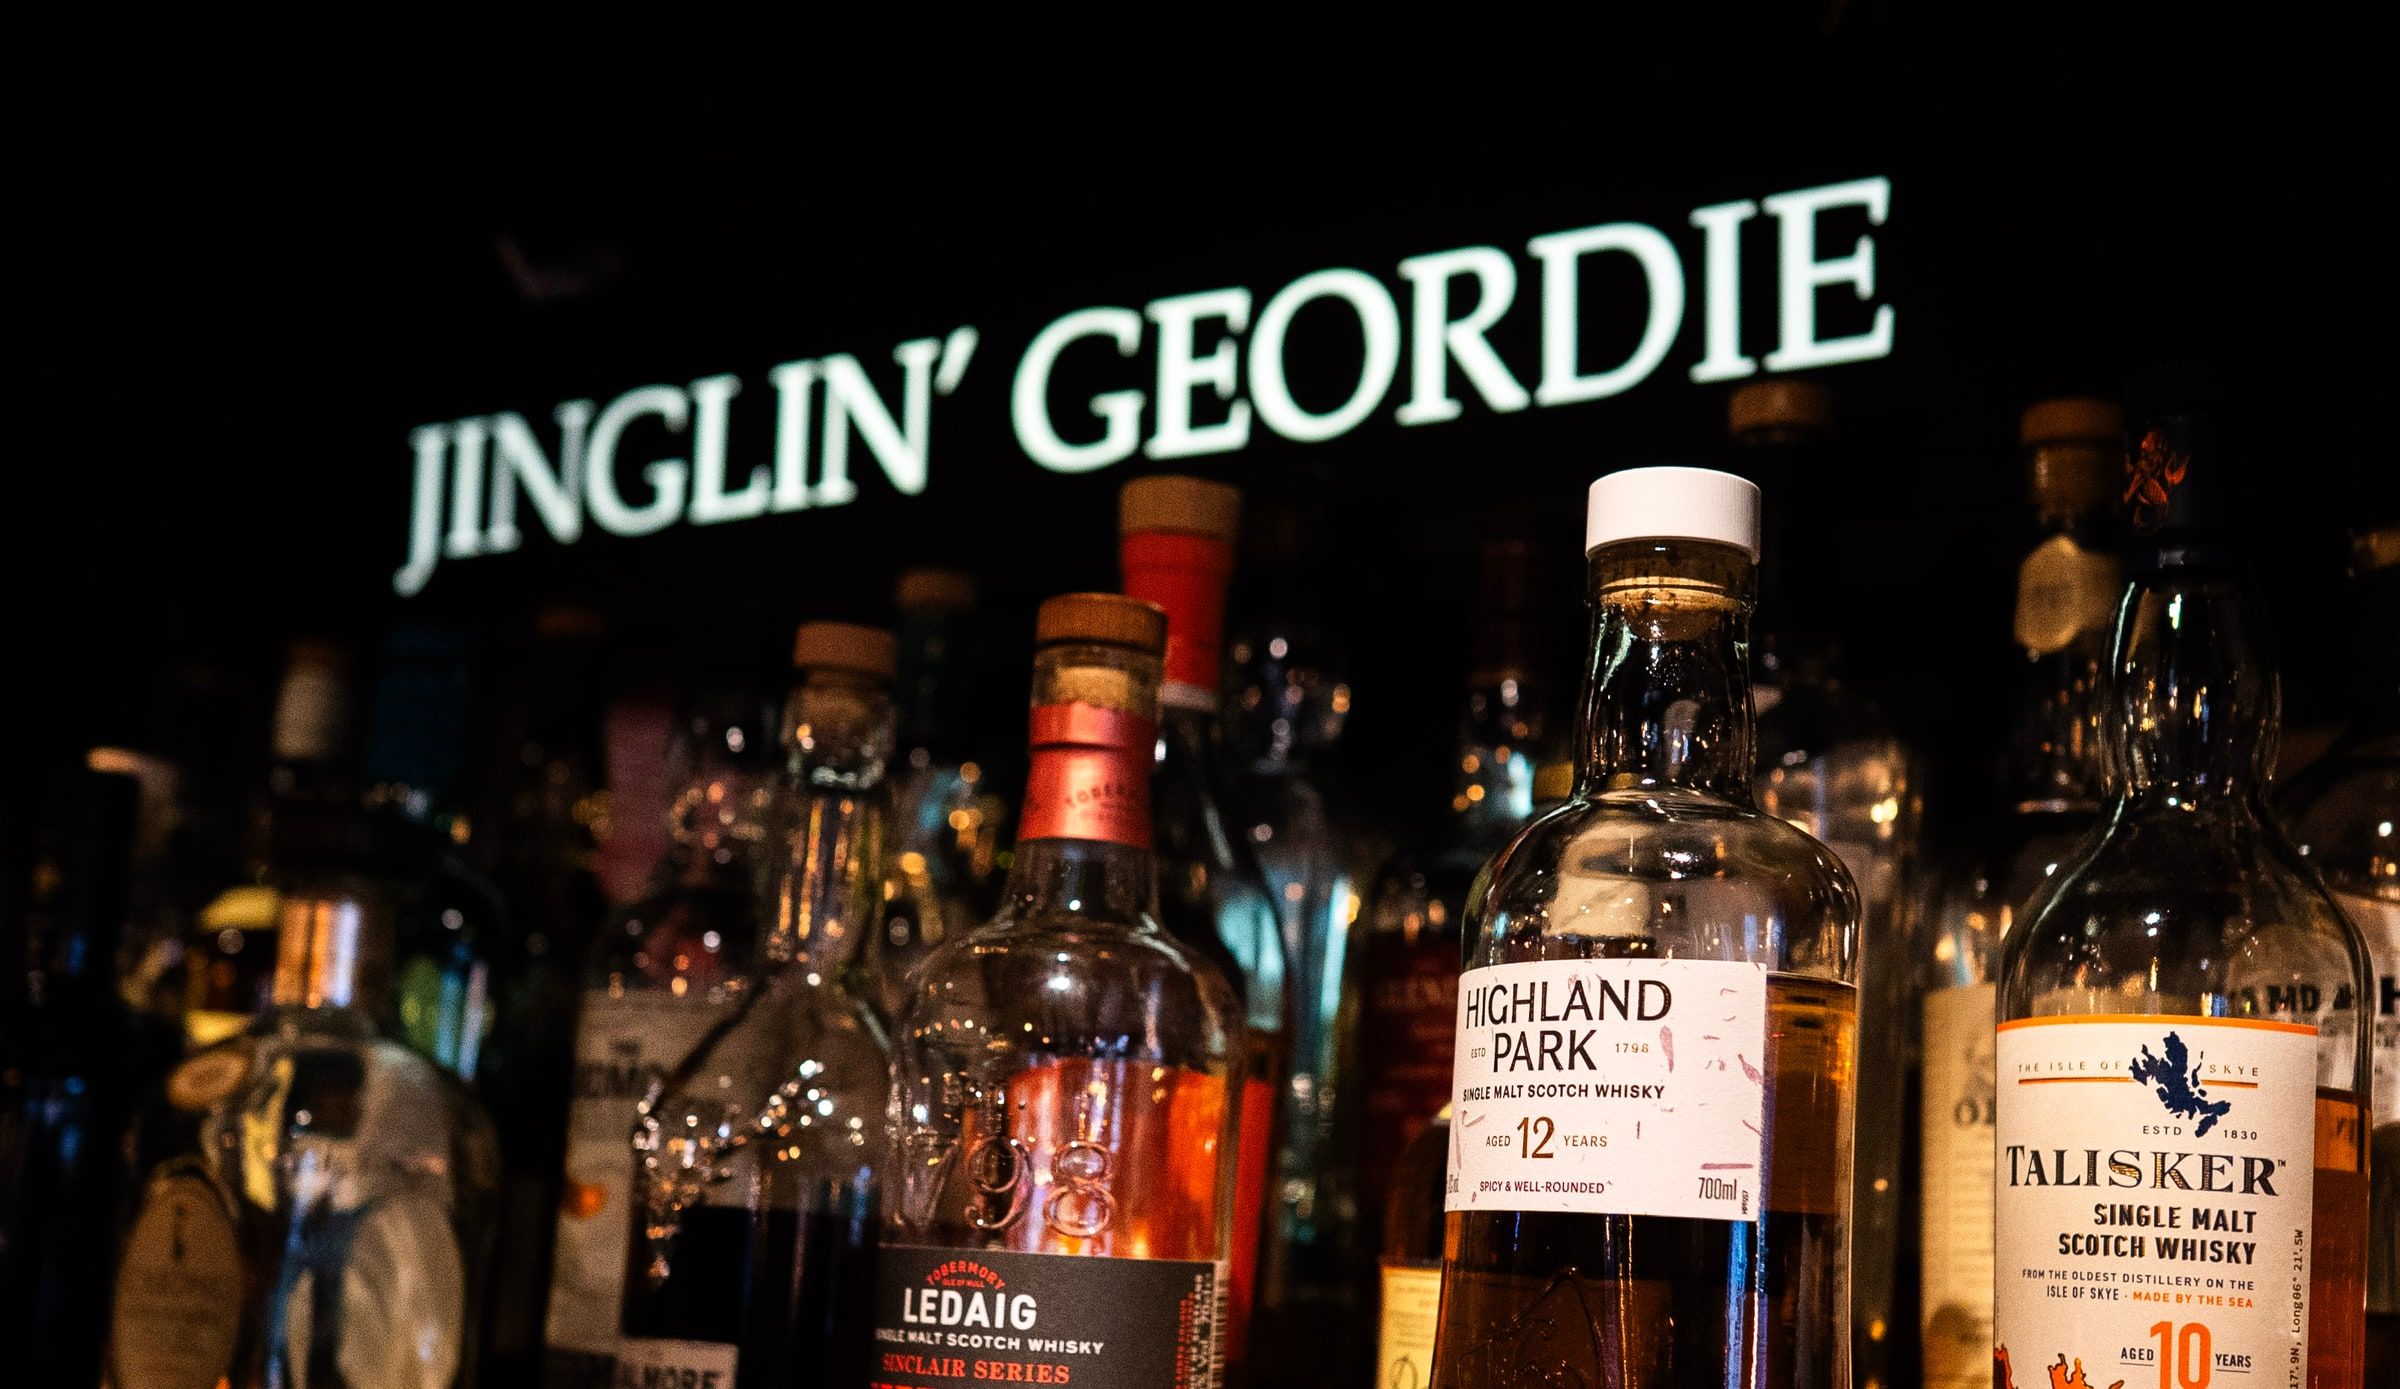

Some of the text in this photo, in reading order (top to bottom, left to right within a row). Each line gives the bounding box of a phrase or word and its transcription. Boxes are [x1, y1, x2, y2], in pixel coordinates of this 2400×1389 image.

[1009, 176, 1896, 475] GEORDIE
[1465, 979, 1673, 1030] HIGHLAND
[1471, 1043, 1649, 1059] ESTD 1798
[1492, 1029, 1598, 1073] PARK
[2018, 1060, 2259, 1077] THE ISLE OF SKYE
[1463, 1084, 1665, 1102] SINGLE MALT SCOTCH WHISKY
[1485, 1116, 1608, 1159] AGED 12 YEARS
[2142, 1125, 2258, 1141] ESTD 1830
[2006, 1144, 2280, 1197] TALISKER
[1479, 1181, 1605, 1194] SPICY & WELL-ROUNDED
[1697, 1176, 1738, 1201] 700ml
[2093, 1203, 2257, 1234] SINGLE MALT
[2058, 1232, 2257, 1266] SCOTCH WHISKY
[926, 1260, 1006, 1291] TOBERMORY
[2022, 1268, 2255, 1291] FROM THE OLDEST DISTILLERY ON THE
[902, 1287, 1038, 1331] LEDAIG
[2046, 1285, 2254, 1309] ISLE OF SKYE MADE BY THE SEA
[907, 1331, 943, 1345] MALT
[946, 1332, 1021, 1351] SCOTCH
[1026, 1338, 1105, 1356] WHISKY
[2120, 1320, 2252, 1389] AGED 10 YEARS
[882, 1352, 1071, 1385] SINCLAIR SERIES
